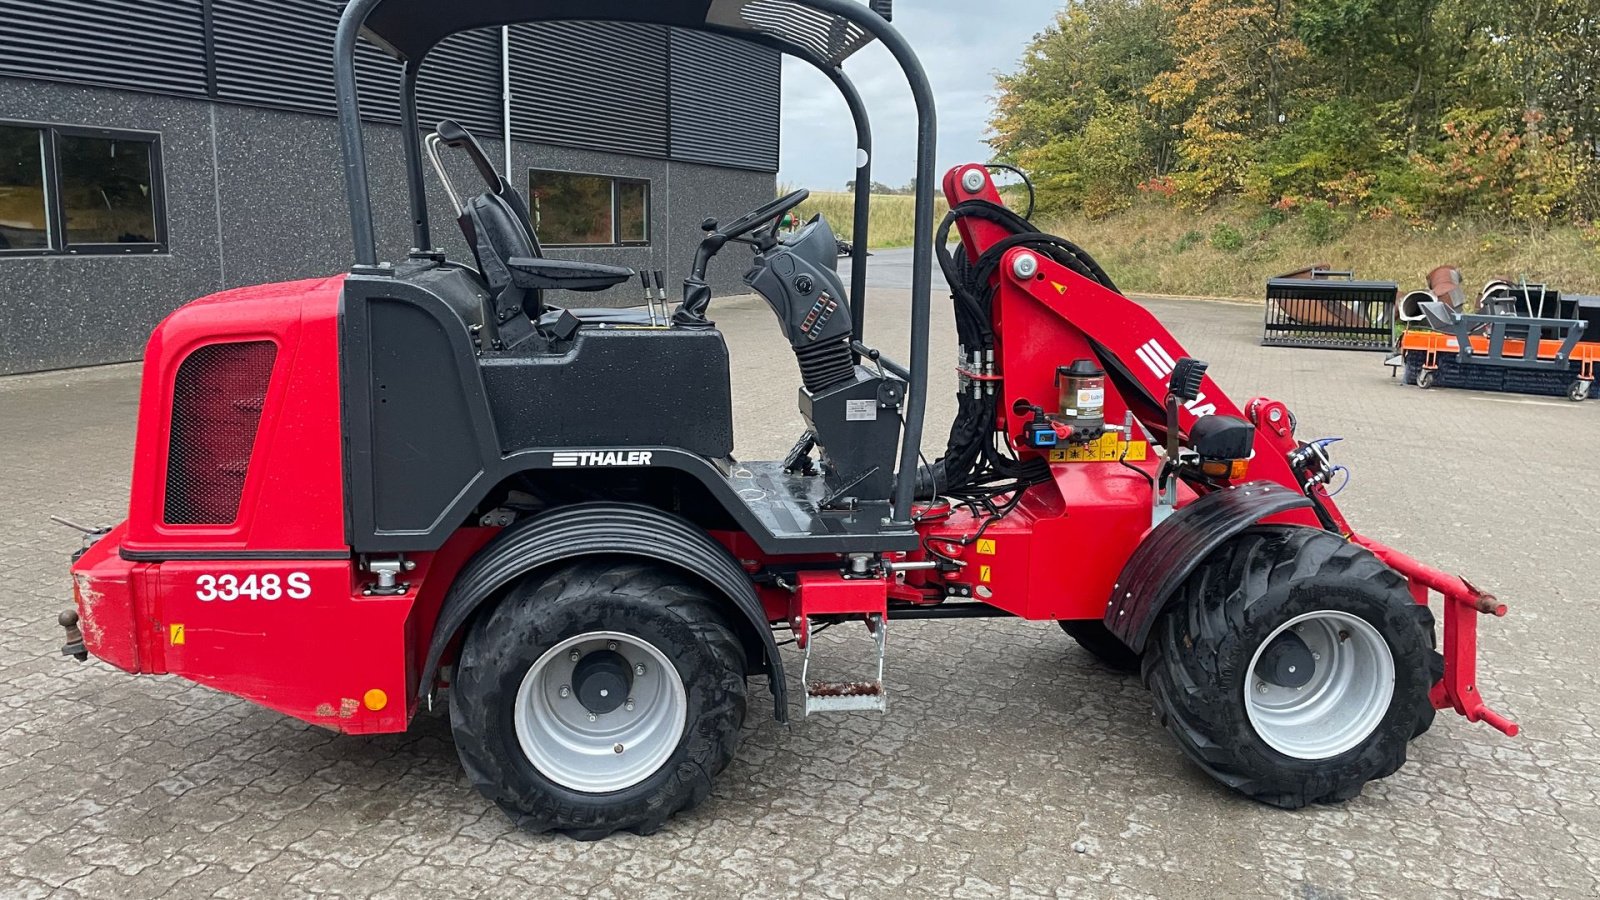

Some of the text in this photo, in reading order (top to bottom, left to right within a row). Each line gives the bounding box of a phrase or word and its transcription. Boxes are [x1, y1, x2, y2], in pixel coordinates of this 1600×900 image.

[577, 451, 653, 466] THALER
[195, 571, 312, 602] 3348 S
